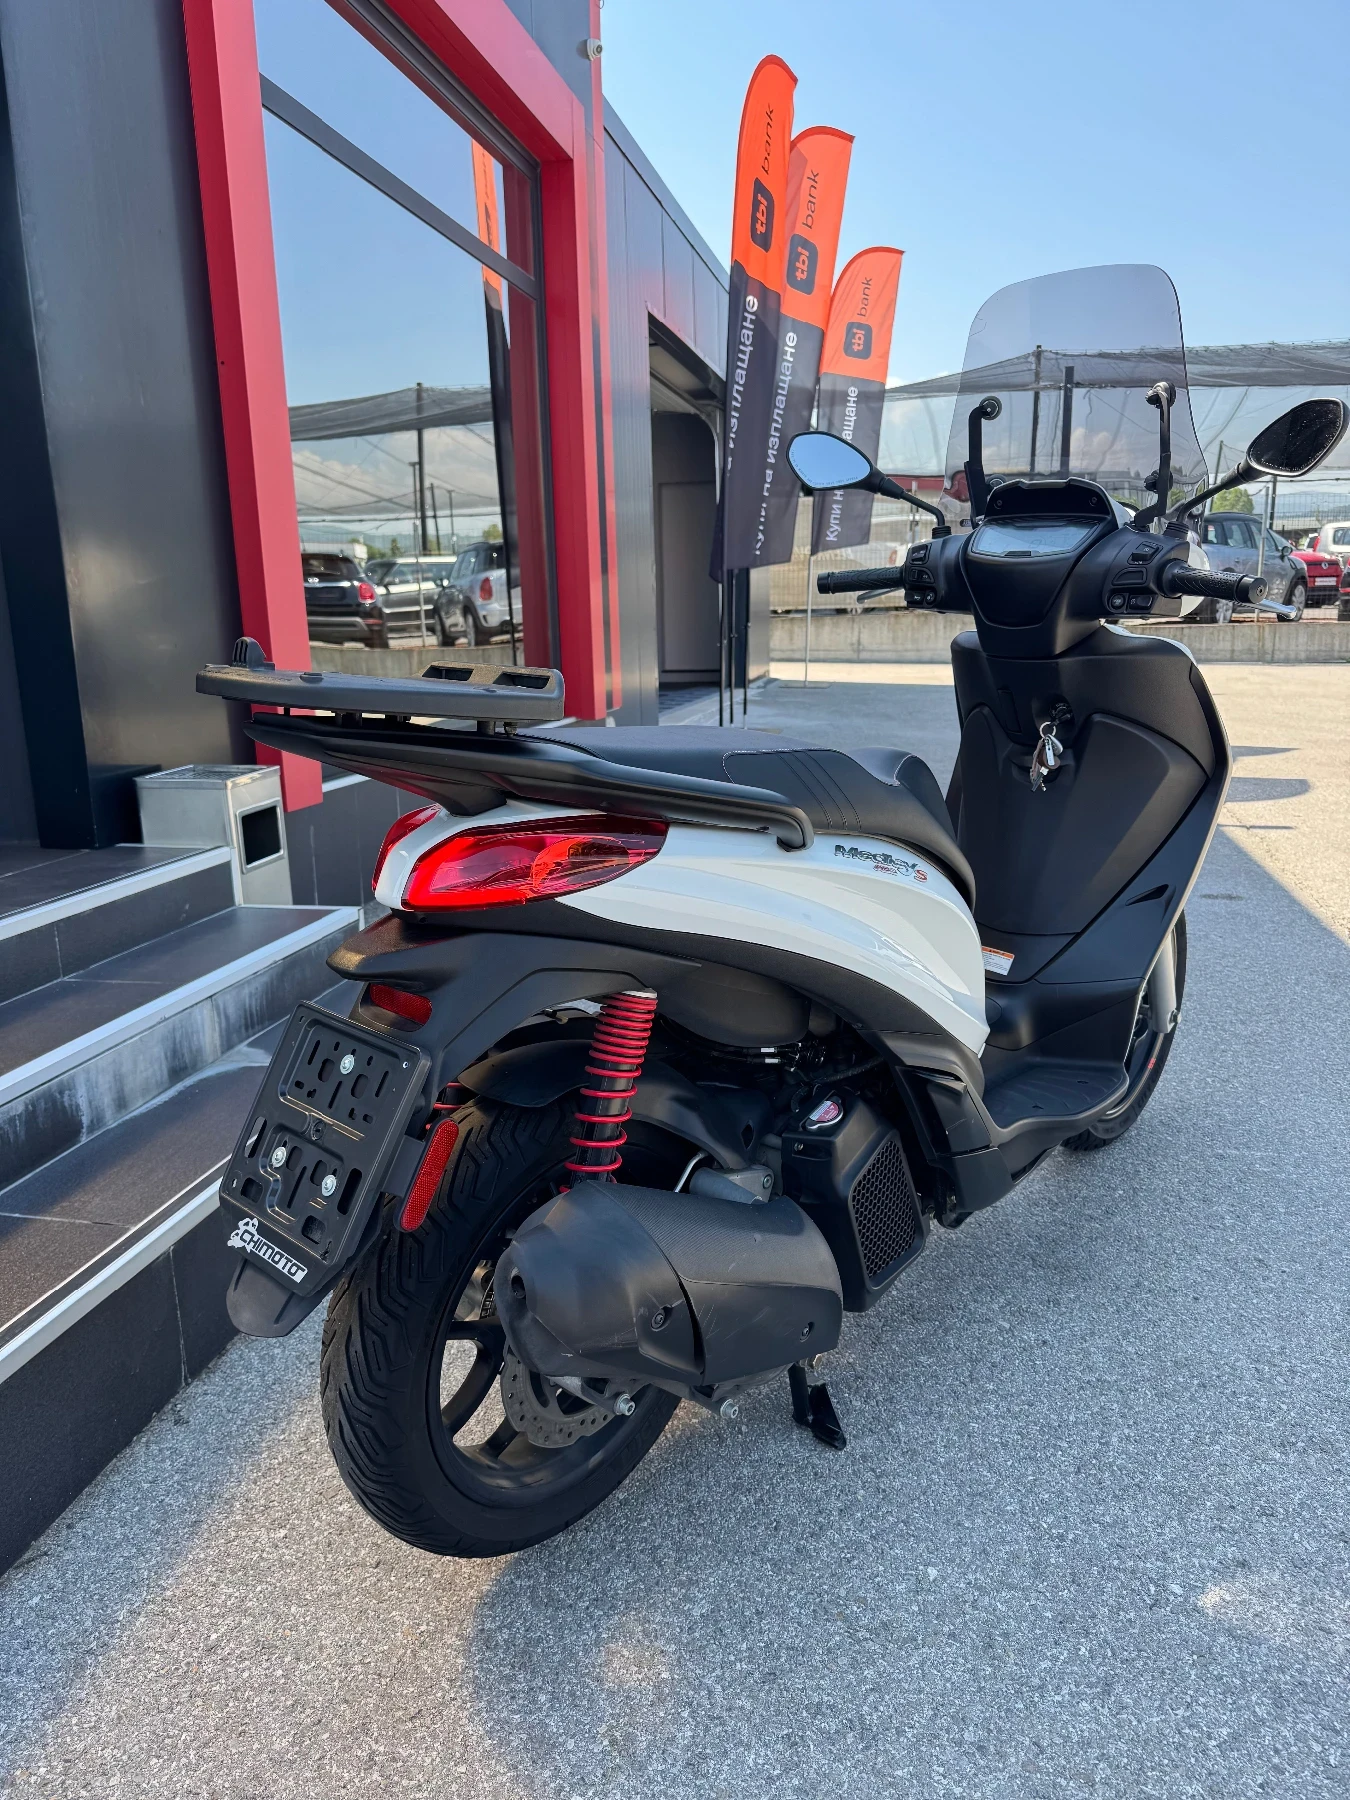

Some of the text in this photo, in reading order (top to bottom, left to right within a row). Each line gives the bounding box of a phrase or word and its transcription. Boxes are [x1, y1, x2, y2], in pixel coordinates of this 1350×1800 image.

[761, 103, 774, 176] bank
[801, 169, 820, 230] bank
[856, 276, 872, 317] bank
[767, 331, 798, 464] изплащане
[833, 489, 844, 501] н
[825, 504, 843, 542] Купи
[834, 844, 918, 877] Medley
[239, 1228, 307, 1277] CHIMOTO
